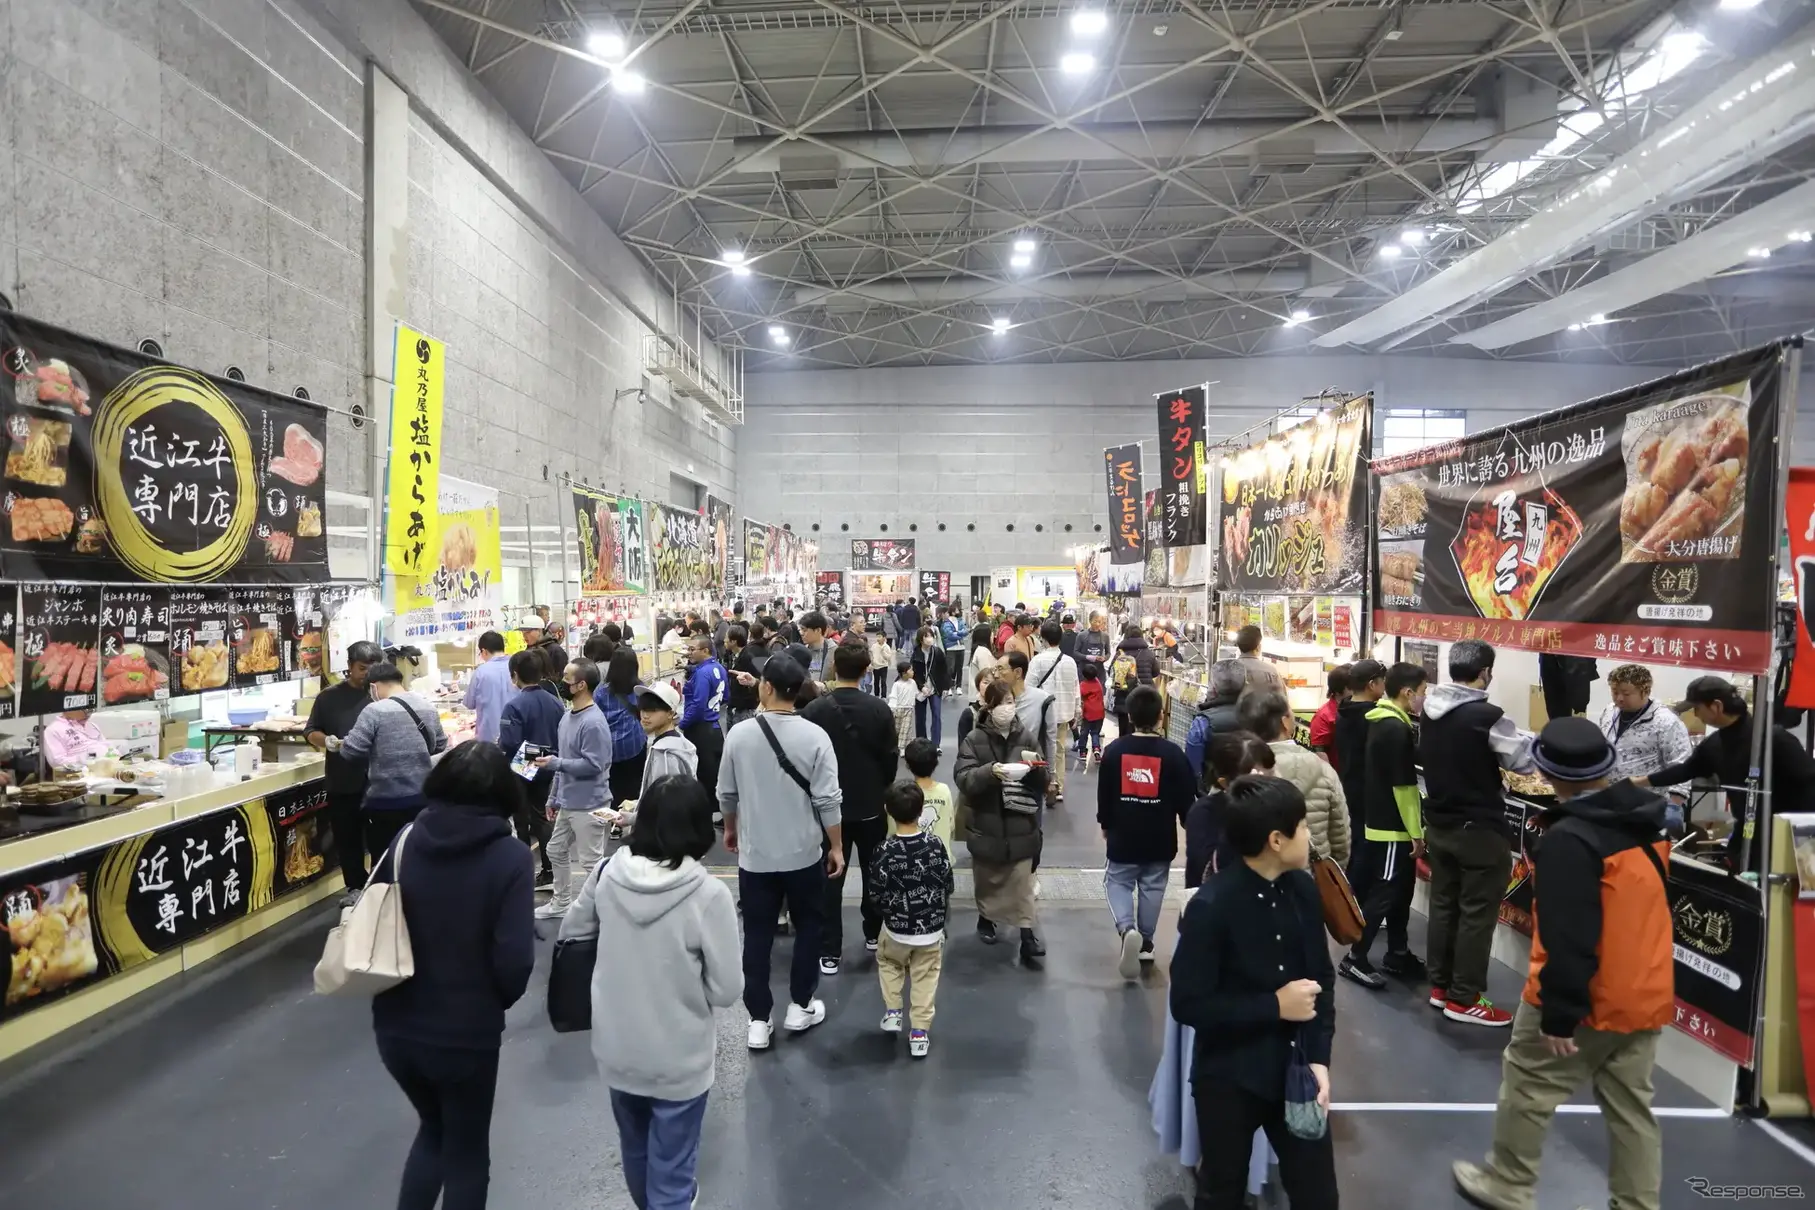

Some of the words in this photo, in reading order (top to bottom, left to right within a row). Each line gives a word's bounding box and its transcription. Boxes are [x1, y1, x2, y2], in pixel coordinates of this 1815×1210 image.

[14, 347, 35, 376] 炙
[416, 365, 428, 412] 丸乃屋
[11, 416, 31, 438] 極
[1651, 399, 1706, 428] karaage
[129, 424, 232, 479] 近江牛
[1169, 398, 1192, 479] 牛タン
[1438, 426, 1606, 490] 世界に誇る九州の逸品
[132, 474, 232, 528] 専門店
[404, 416, 431, 571] 塩からあげ
[1178, 481, 1190, 517] 粗挽き
[1166, 493, 1177, 543] フランク
[1528, 511, 1543, 552] 九州
[1492, 489, 1524, 596] 屋台
[1664, 534, 1738, 558] 大分唐揚げ
[24, 585, 82, 594] 近江牛専門店の
[1659, 566, 1694, 592] 金賞
[44, 599, 87, 613] ジャンボ
[103, 592, 151, 601] 近江牛専門店の
[170, 602, 229, 615] ホルモン焼きそば
[228, 602, 278, 614] 近江牛焼きそば
[26, 614, 99, 627] 近江牛ステーキ串
[102, 606, 169, 628] 炙り肉寿司
[1645, 606, 1704, 619] 唐揚げ発祥の地
[24, 632, 45, 656] 極
[104, 635, 120, 656] 炙
[1594, 633, 1742, 660] 逸品をご賞味下さい
[138, 819, 245, 893] 近江牛
[155, 868, 242, 934] 専門店
[1680, 902, 1727, 945] 金賞
[1672, 948, 1731, 984] 揚げ発祥の地
